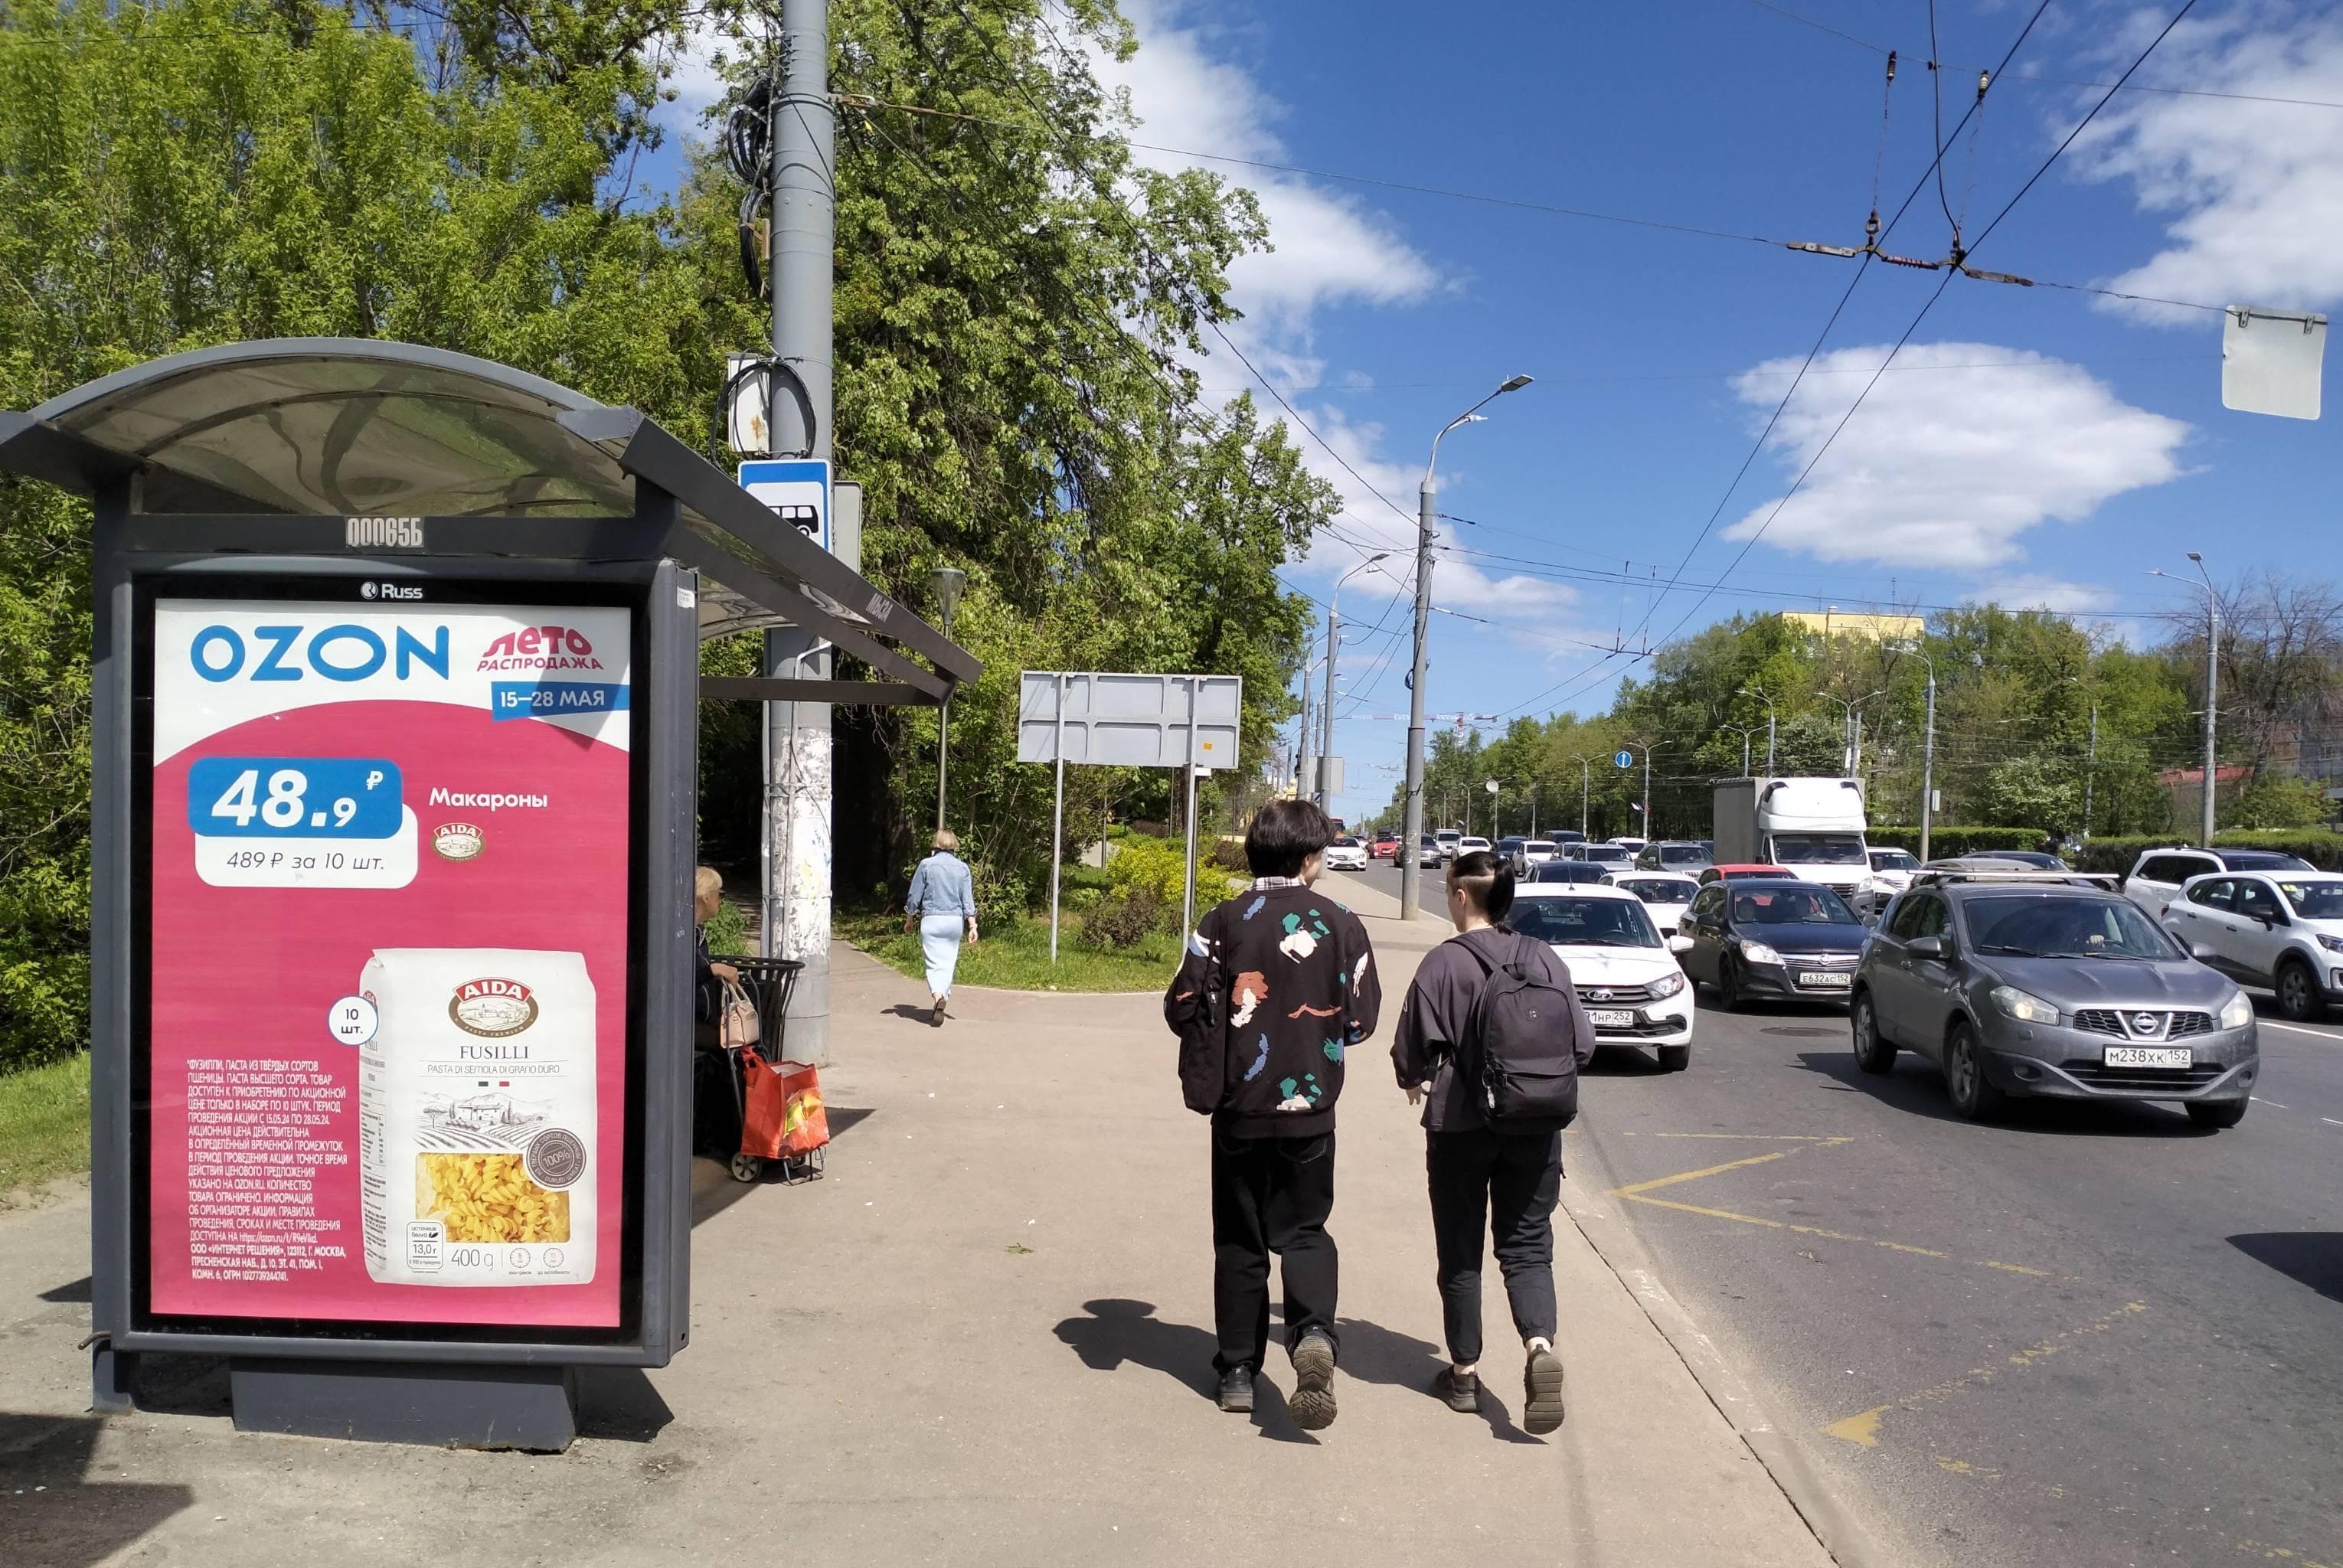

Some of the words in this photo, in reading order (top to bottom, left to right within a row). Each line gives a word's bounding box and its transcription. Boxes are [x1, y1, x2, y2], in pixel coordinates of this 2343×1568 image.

[381, 583, 423, 599] Russ
[866, 593, 893, 622] МЫЗА
[191, 624, 449, 682] OZON
[476, 656, 604, 671] РАСПРОДАЖА
[559, 690, 605, 707] МАЯ
[429, 787, 548, 812] Макароны
[440, 825, 477, 837] AIDA
[227, 852, 265, 870] 489
[292, 856, 316, 870] за
[325, 853, 345, 869] 10
[352, 857, 384, 871] шт.
[463, 981, 523, 1000] AIDA
[346, 1008, 359, 1021] 10
[1613, 1011, 1631, 1021] 252
[459, 1045, 529, 1060] FUSILLI
[2168, 1050, 2188, 1060] 152
[226, 1060, 247, 1070] ПАСТА
[249, 1060, 258, 1070] ИЗ
[291, 1060, 319, 1072] СОРТОВ
[227, 1073, 248, 1084] ПАСТА
[250, 1073, 283, 1085] ВЫСШЕГО
[310, 1074, 332, 1085] ТОВАР
[226, 1086, 230, 1096] К
[232, 1086, 286, 1098] ПРИОБРЕТЕНИЮ
[289, 1087, 299, 1098] ПО
[301, 1086, 346, 1099] АКЦИОННОЙ
[188, 1099, 205, 1110] ЦЕНЕ
[207, 1099, 234, 1110] ТОЛЬКО
[242, 1100, 268, 1110] НАБОРЕ
[270, 1100, 281, 1110] ПО
[283, 1101, 289, 1110] 10
[313, 1101, 341, 1113] ПЕРИОД
[188, 1112, 232, 1124] ПРОВЕДЕНИЯ
[234, 1113, 257, 1125] АКЦИИ
[260, 1114, 264, 1123] С
[266, 1114, 289, 1124] 15.05.24
[291, 1114, 302, 1124] ПО
[188, 1125, 231, 1137] АКЦИОННАЯ
[234, 1126, 251, 1137] ЦЕНА
[253, 1125, 309, 1138] ДЕЙСТВИТЕЛЬНА
[188, 1139, 193, 1148] В
[251, 1138, 292, 1150] ВРЕМЕННОЙ
[295, 1140, 343, 1152] ПРОМЕЖУТОК
[188, 1152, 193, 1161] В
[194, 1152, 222, 1163] ПЕРИОД
[224, 1152, 268, 1163] ПРОВЕДЕНИЯ
[296, 1154, 323, 1164] ТОЧНОЕ
[325, 1154, 347, 1165] ВРЕМЯ
[543, 1149, 570, 1167] 100%
[188, 1165, 223, 1176] ДЕЙСТВИЯ
[225, 1166, 262, 1177] ЦЕНОВОГО
[263, 1166, 315, 1178] ПРЕДЛОЖЕНИЯ
[188, 1178, 221, 1189] УКАЗАНО
[223, 1179, 232, 1189] НА
[267, 1180, 312, 1191] КОЛИЧЕСТВО
[188, 1191, 214, 1202] ТОВАРА
[263, 1193, 312, 1205] ИНФОРМАЦИЯ
[188, 1204, 198, 1215] ОБ
[200, 1205, 250, 1216] ОРГАНИЗАТОРЕ
[237, 1219, 263, 1230] СРОКАХ
[266, 1219, 271, 1229] И
[273, 1220, 294, 1230] МЕСТЕ
[296, 1220, 340, 1231] ПРОВЕДЕНИЯ
[228, 1231, 237, 1241] НА
[413, 1243, 432, 1256] 13,0
[191, 1256, 240, 1267] ПРЕСНЕНСКАЯ
[451, 1249, 480, 1267] 400
[483, 1253, 494, 1272] g
[224, 1270, 240, 1280] ОГРН
